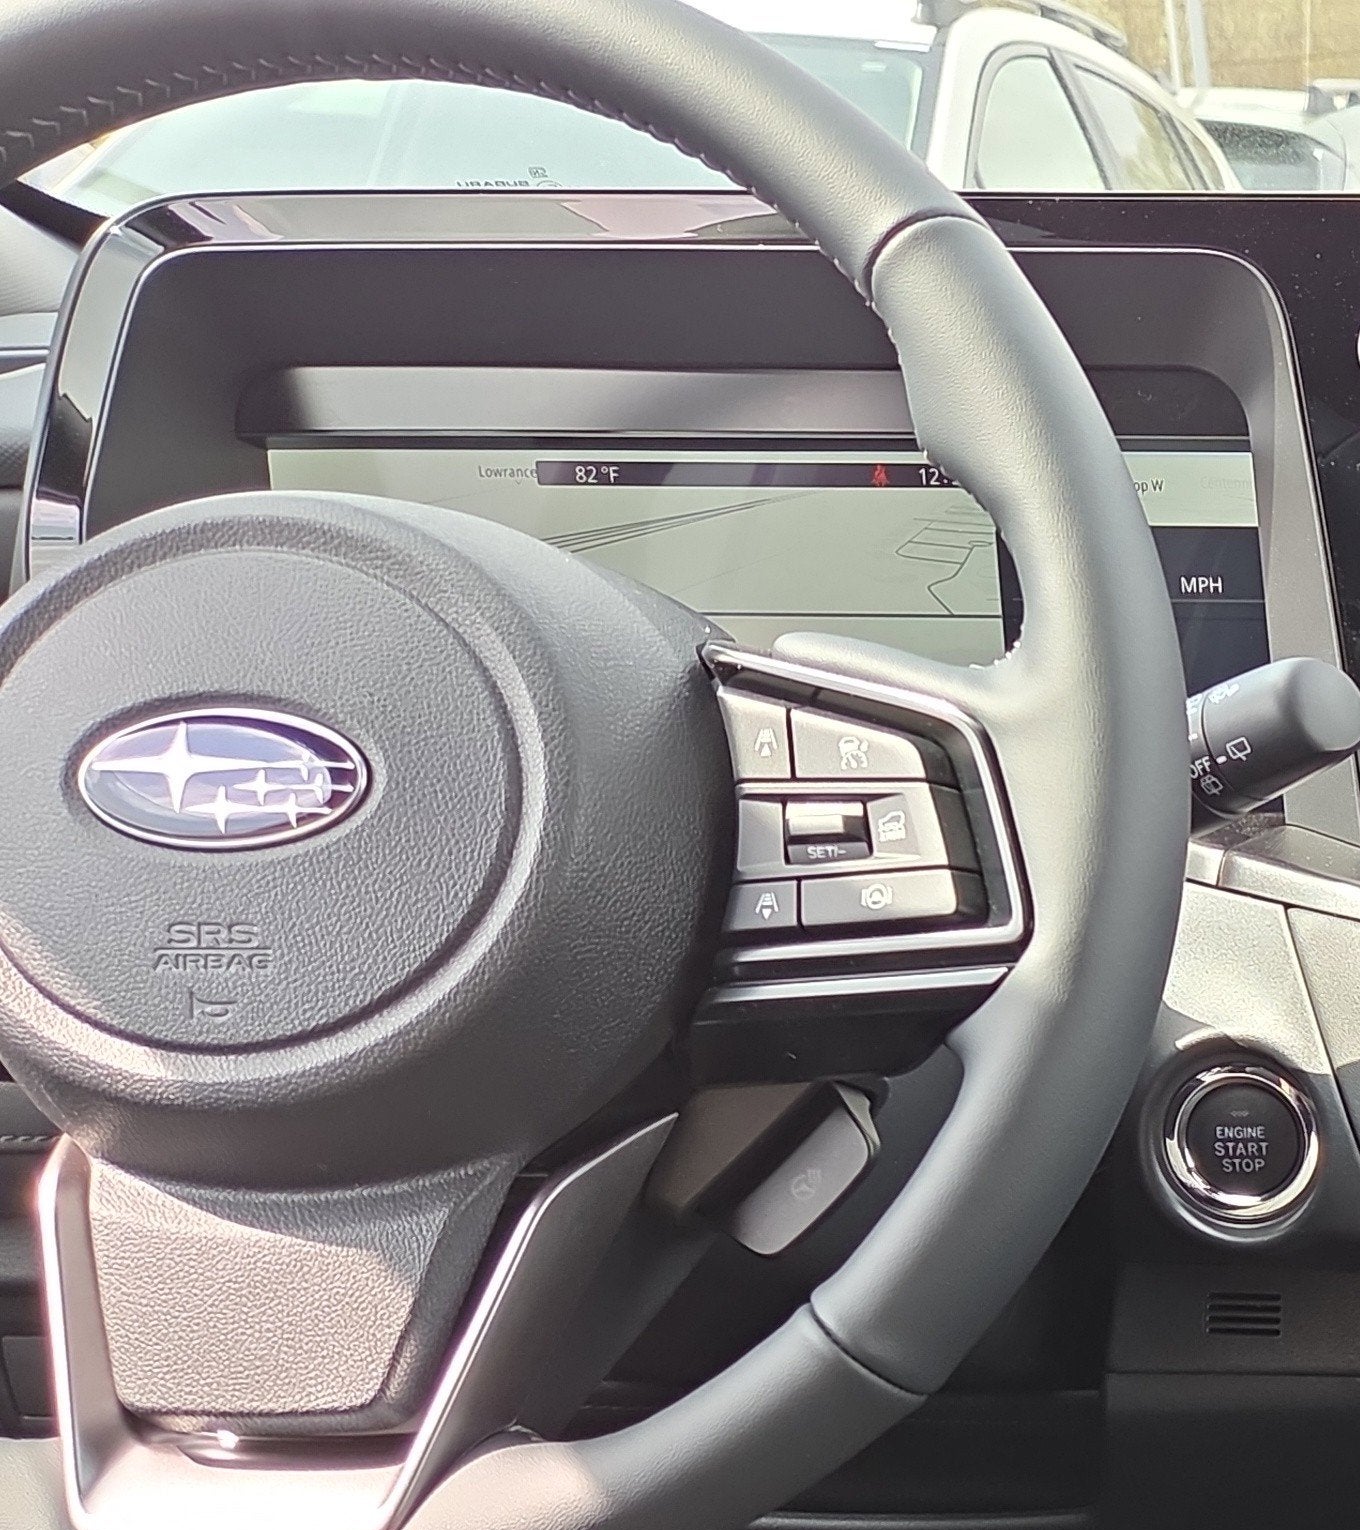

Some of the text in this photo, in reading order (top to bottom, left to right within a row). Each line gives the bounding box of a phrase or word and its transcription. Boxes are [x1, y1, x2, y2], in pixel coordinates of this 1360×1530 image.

[478, 465, 538, 479] Lowrance
[1151, 479, 1164, 492] W
[1180, 576, 1223, 594] MPH
[167, 921, 260, 949] SRS
[153, 952, 273, 972] AIRBAG
[1215, 1126, 1266, 1139] ENGINE
[1214, 1142, 1269, 1157] START
[1222, 1158, 1266, 1173] STOP
